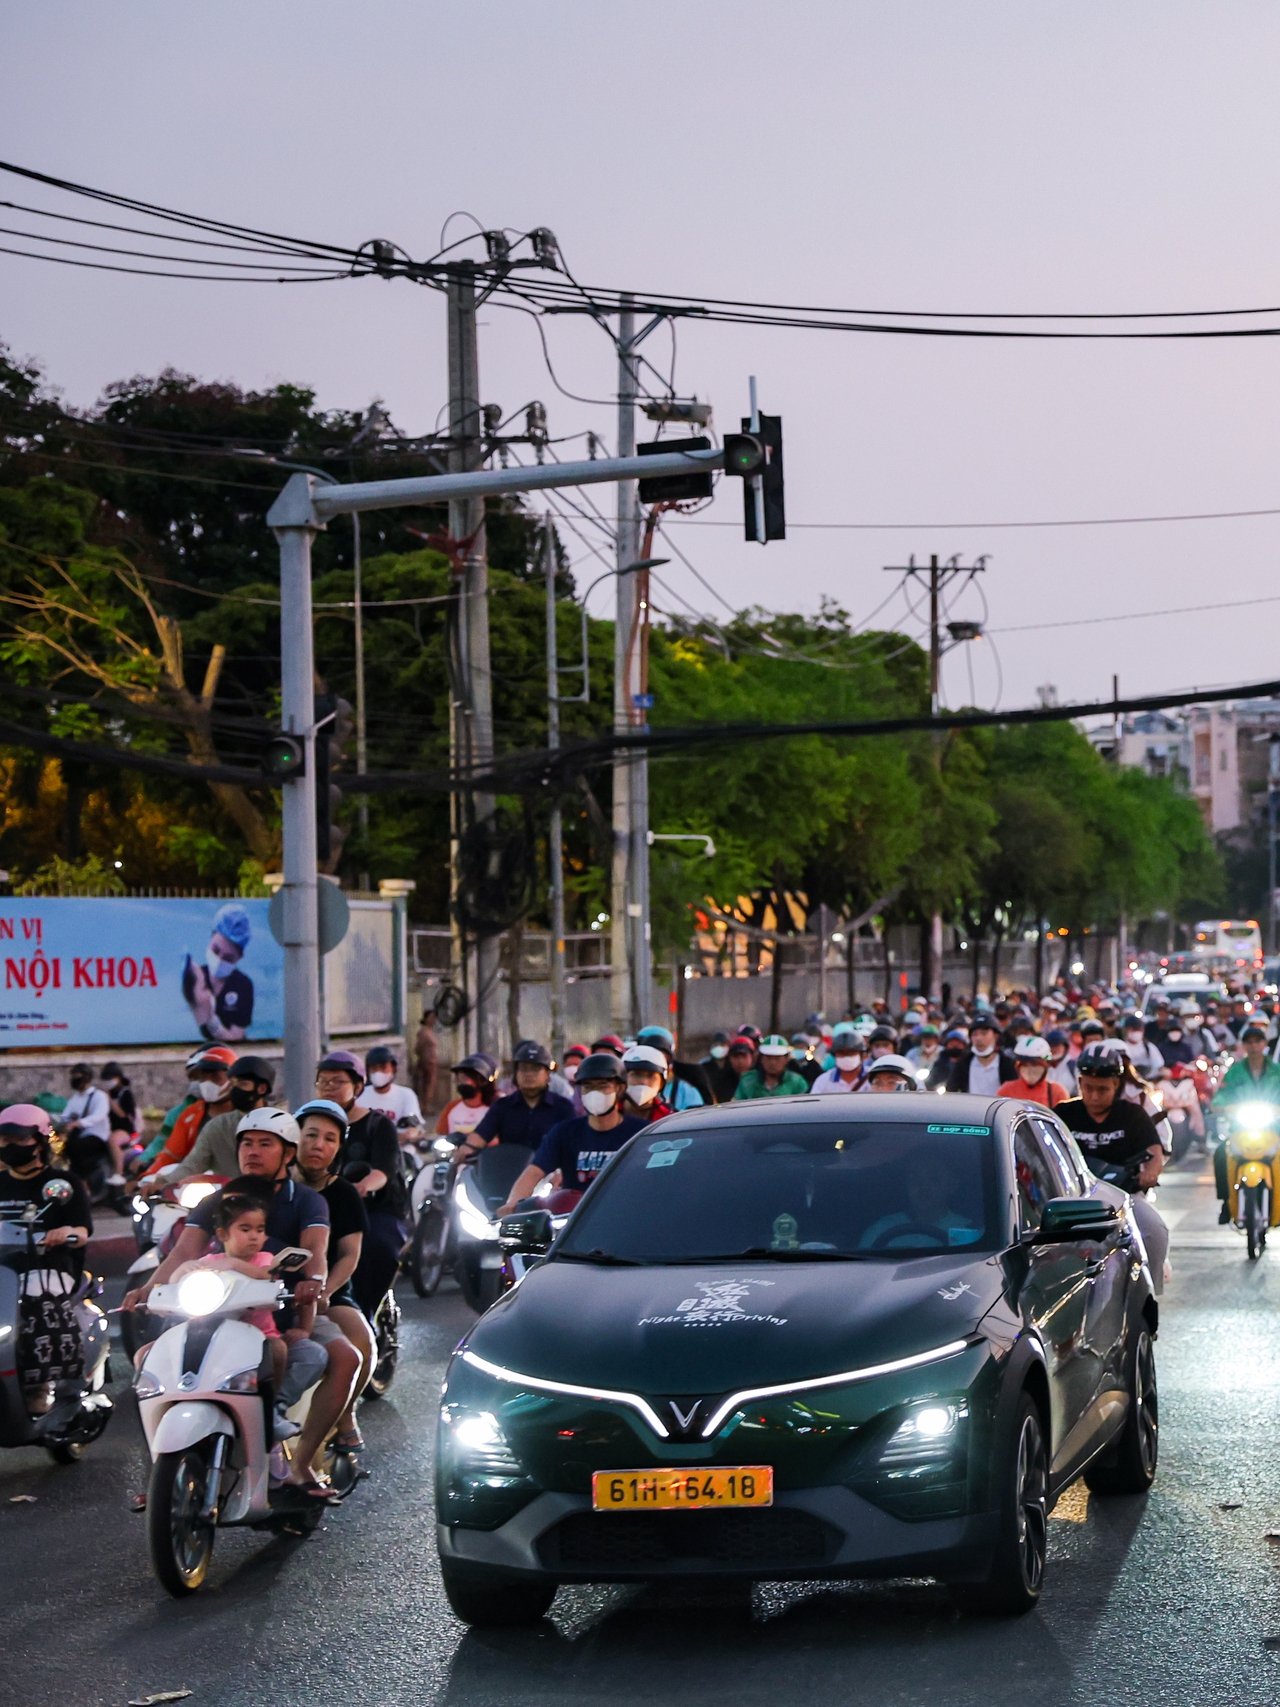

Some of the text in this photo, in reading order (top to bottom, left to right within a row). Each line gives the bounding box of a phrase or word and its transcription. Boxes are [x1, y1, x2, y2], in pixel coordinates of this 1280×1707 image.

[21, 917, 42, 946] VỊ
[5, 948, 158, 998] NỘI KHOA
